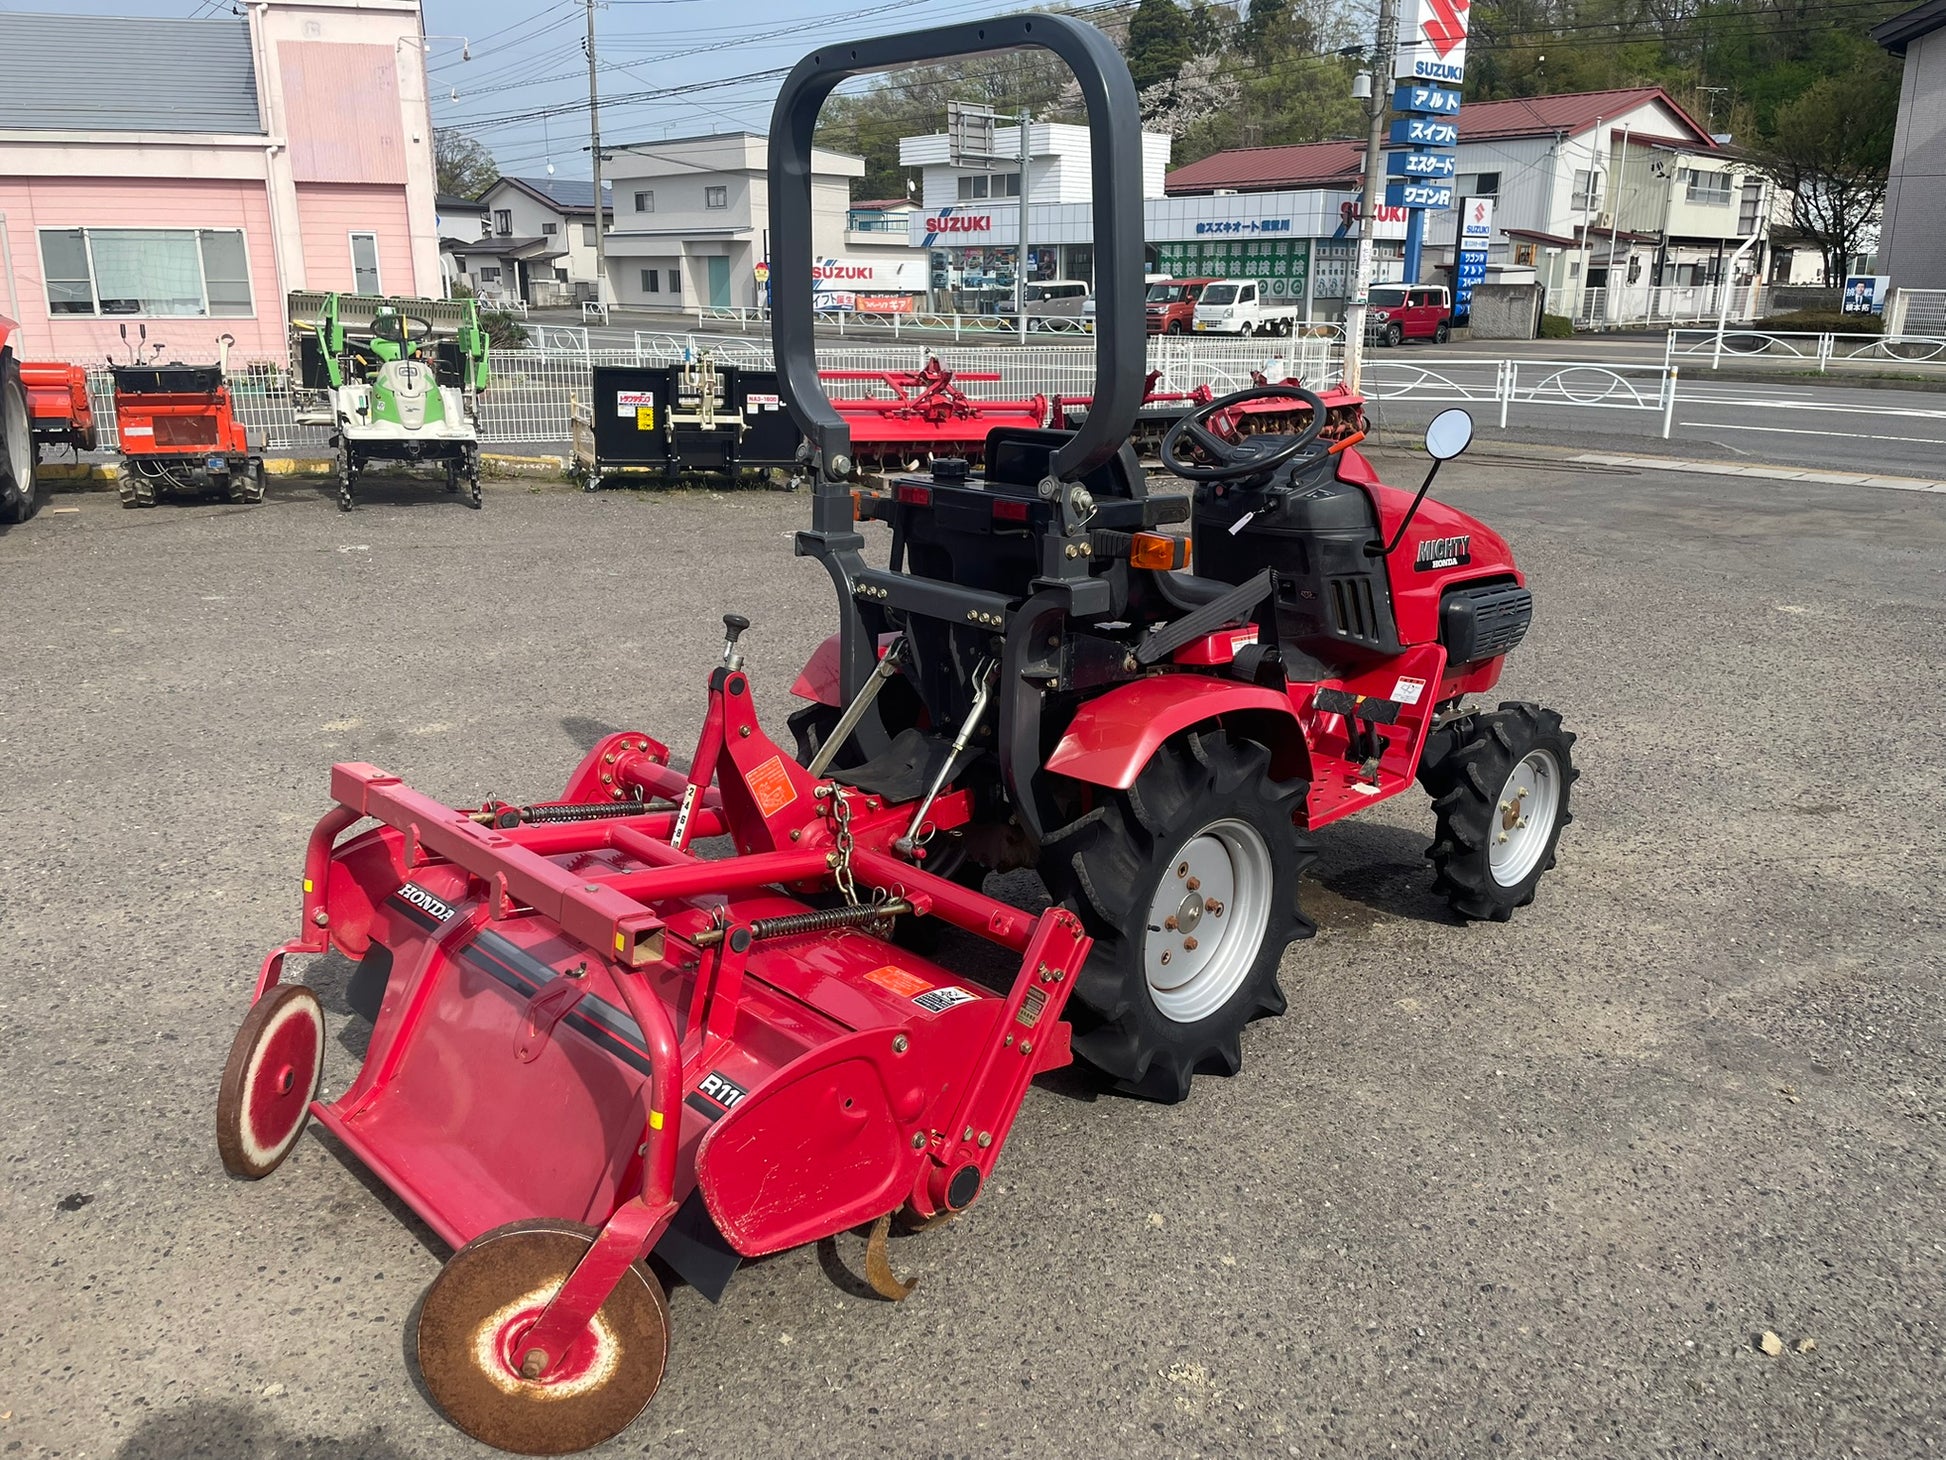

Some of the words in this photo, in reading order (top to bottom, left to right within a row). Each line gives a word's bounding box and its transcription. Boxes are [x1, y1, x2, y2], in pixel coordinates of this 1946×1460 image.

[1415, 61, 1463, 80] SUZUKI
[1415, 89, 1458, 111] アルト
[1410, 123, 1457, 142] スイフト
[1406, 156, 1455, 174] エスクード
[1404, 187, 1451, 206] ワゴンR
[1341, 202, 1407, 222] SUUKI
[926, 216, 991, 232] SUZUKI
[1466, 225, 1490, 234] SUZUKI
[1173, 245, 1183, 276] 車検
[1186, 245, 1198, 276] 車検
[1202, 244, 1214, 275] 車検
[1215, 244, 1226, 276] 車検
[1230, 243, 1241, 275] 車検
[1246, 243, 1259, 275] 車検
[1259, 243, 1271, 275] 車検
[1275, 243, 1288, 275] 車検
[1293, 242, 1306, 275] 車検
[1465, 253, 1485, 263] ワゴンR
[812, 266, 873, 279] SUZUKI
[813, 293, 854, 307] イフト誕生
[1417, 535, 1470, 562] MIGHTY
[1432, 558, 1458, 568] HONDA
[688, 787, 695, 796] 2
[684, 801, 690, 810] 4
[397, 883, 455, 922] HONDA
